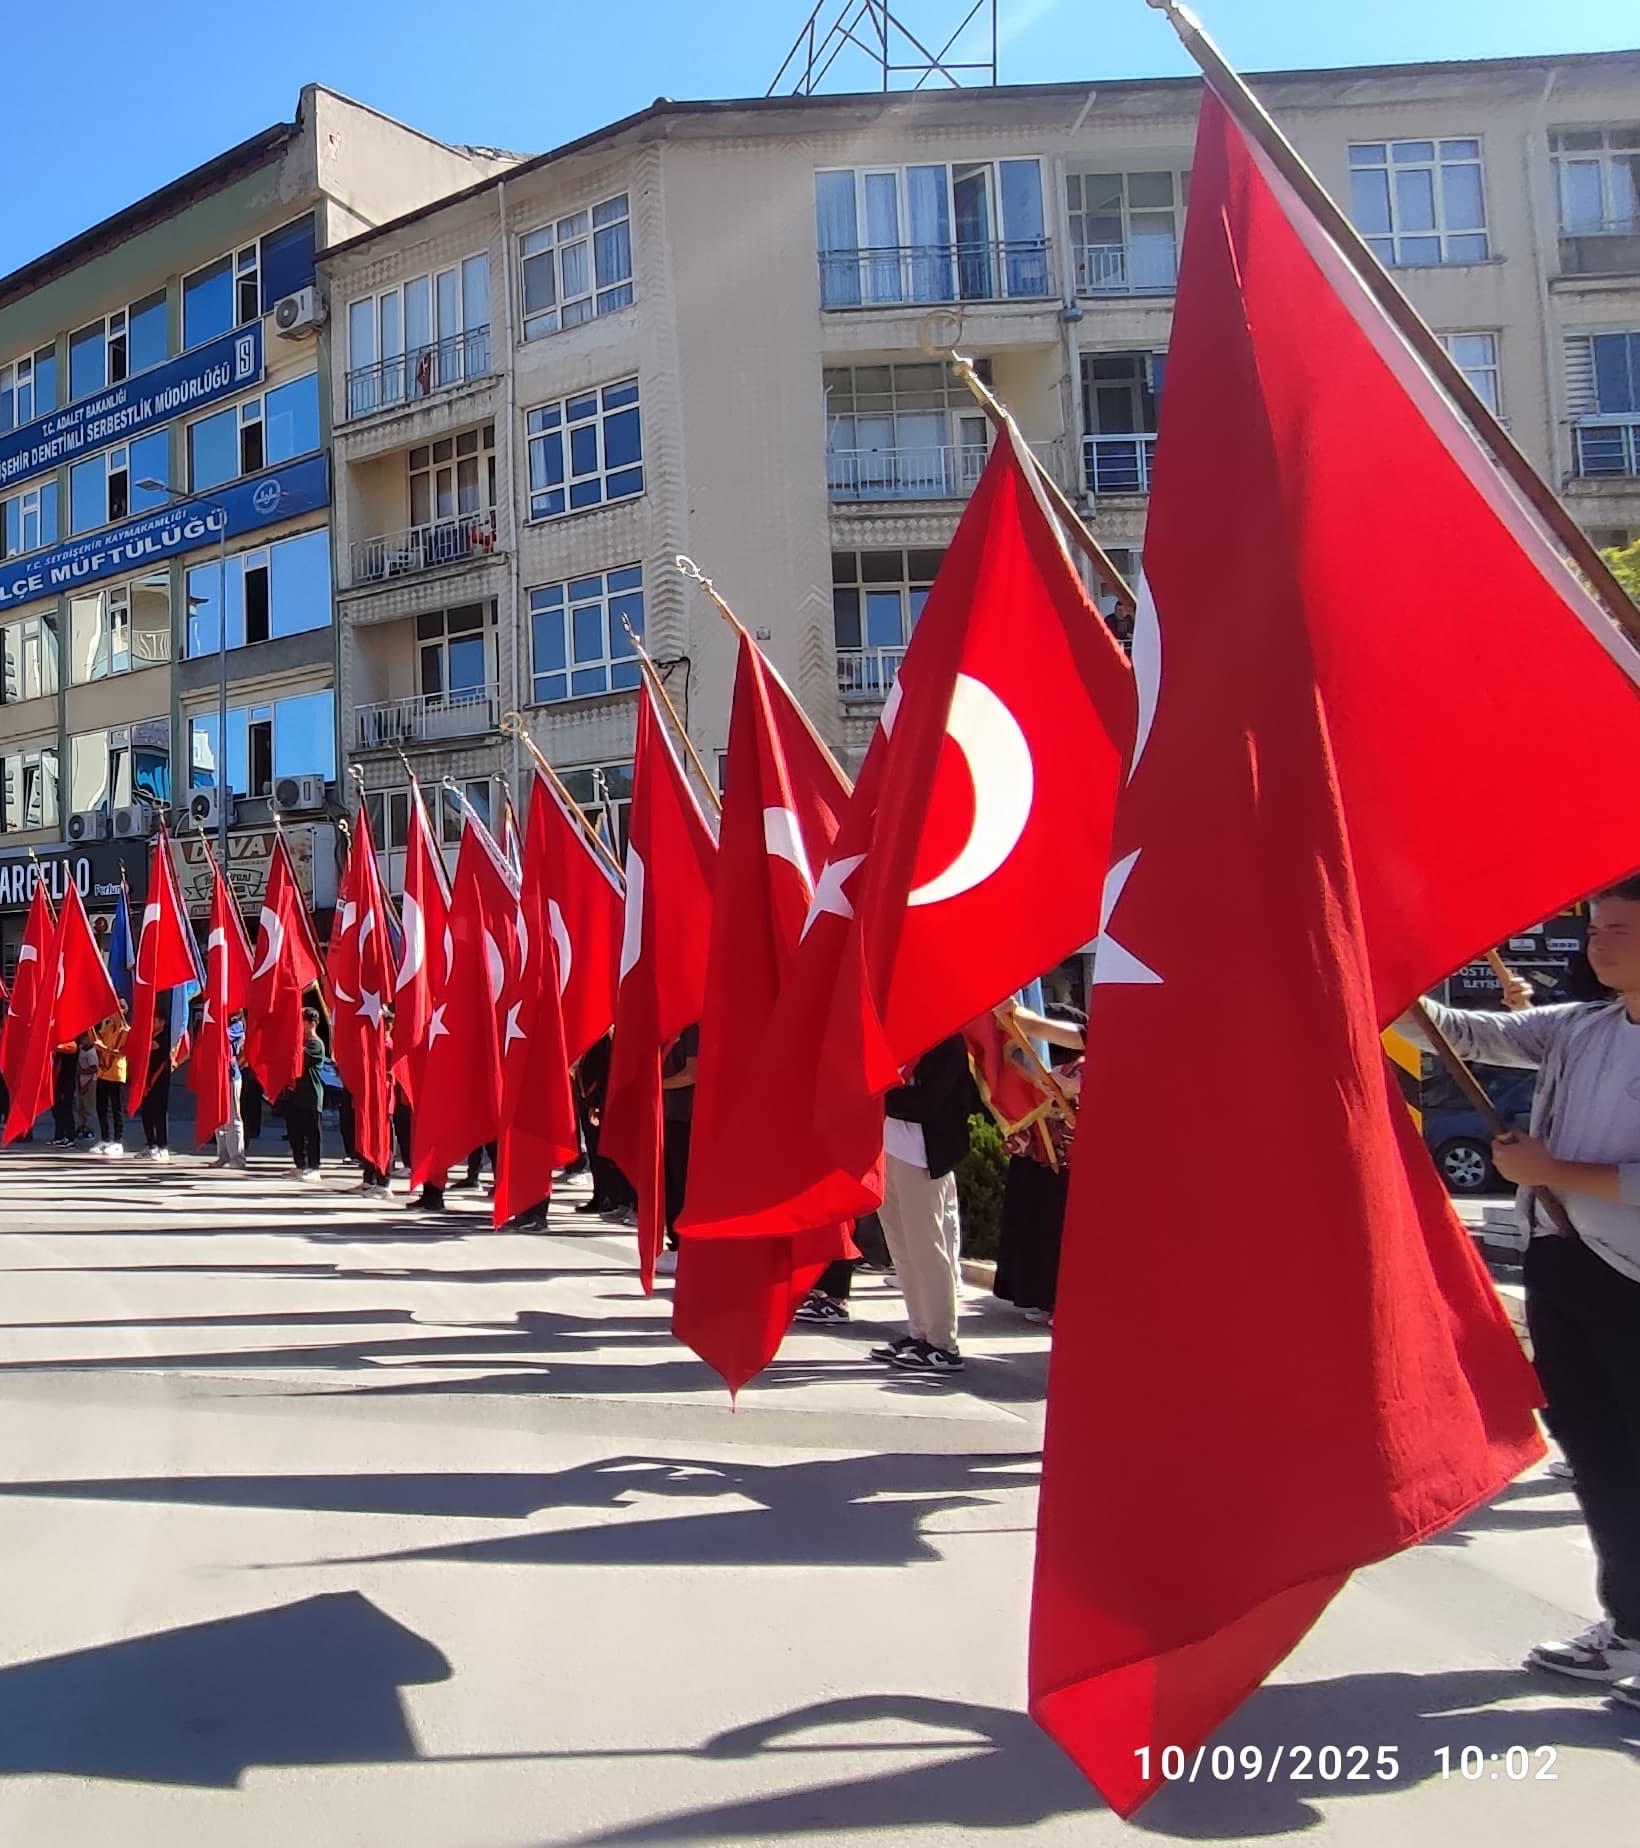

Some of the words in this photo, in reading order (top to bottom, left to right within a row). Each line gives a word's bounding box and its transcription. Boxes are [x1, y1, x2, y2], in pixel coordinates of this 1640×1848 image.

[31, 424, 84, 467] DENETİMLİ
[87, 396, 153, 442] SERBESTLİK
[155, 361, 231, 413] MÜDÜRLÜĞÜ
[42, 421, 56, 437] T.C.
[56, 407, 84, 431] ADALET
[86, 387, 127, 418] BAKANLIĞI
[44, 540, 102, 566] SEYDİŞEHİR
[105, 508, 188, 546] KAYMAKAMLIĞI
[50, 507, 228, 585] MÜFTÜLÜĞÜ
